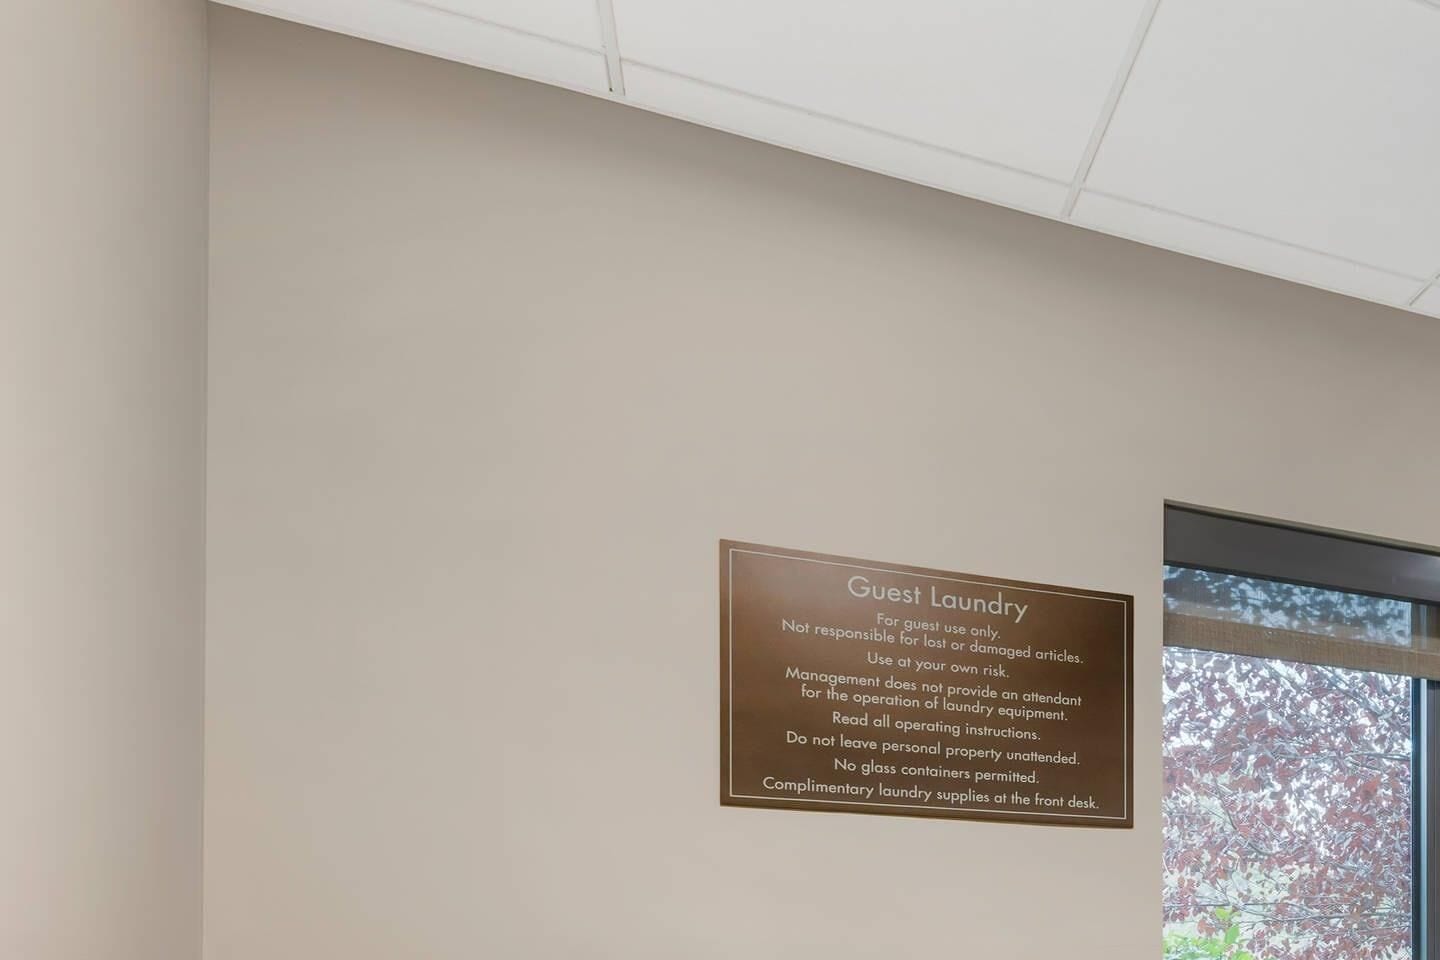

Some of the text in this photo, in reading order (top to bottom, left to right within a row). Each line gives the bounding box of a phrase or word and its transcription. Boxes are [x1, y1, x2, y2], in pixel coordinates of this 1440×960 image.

[847, 575, 1028, 623] Guest Laundry
[782, 618, 1084, 664] Not responsible for lost or damaged articles.
[877, 612, 1001, 641] For guest use only.
[867, 651, 1010, 678] Use at your own risk.
[785, 666, 1082, 706] Management does not provide an attendant
[801, 683, 1068, 721] for the operation of laundry equipment.
[832, 711, 1041, 741] Read all operating instructions.
[786, 730, 1080, 765] Do not leave personal property unattended.
[834, 757, 1040, 784] No glass containers permitted.
[762, 776, 1100, 809] Complimentary laundry supplies at the front desk.
